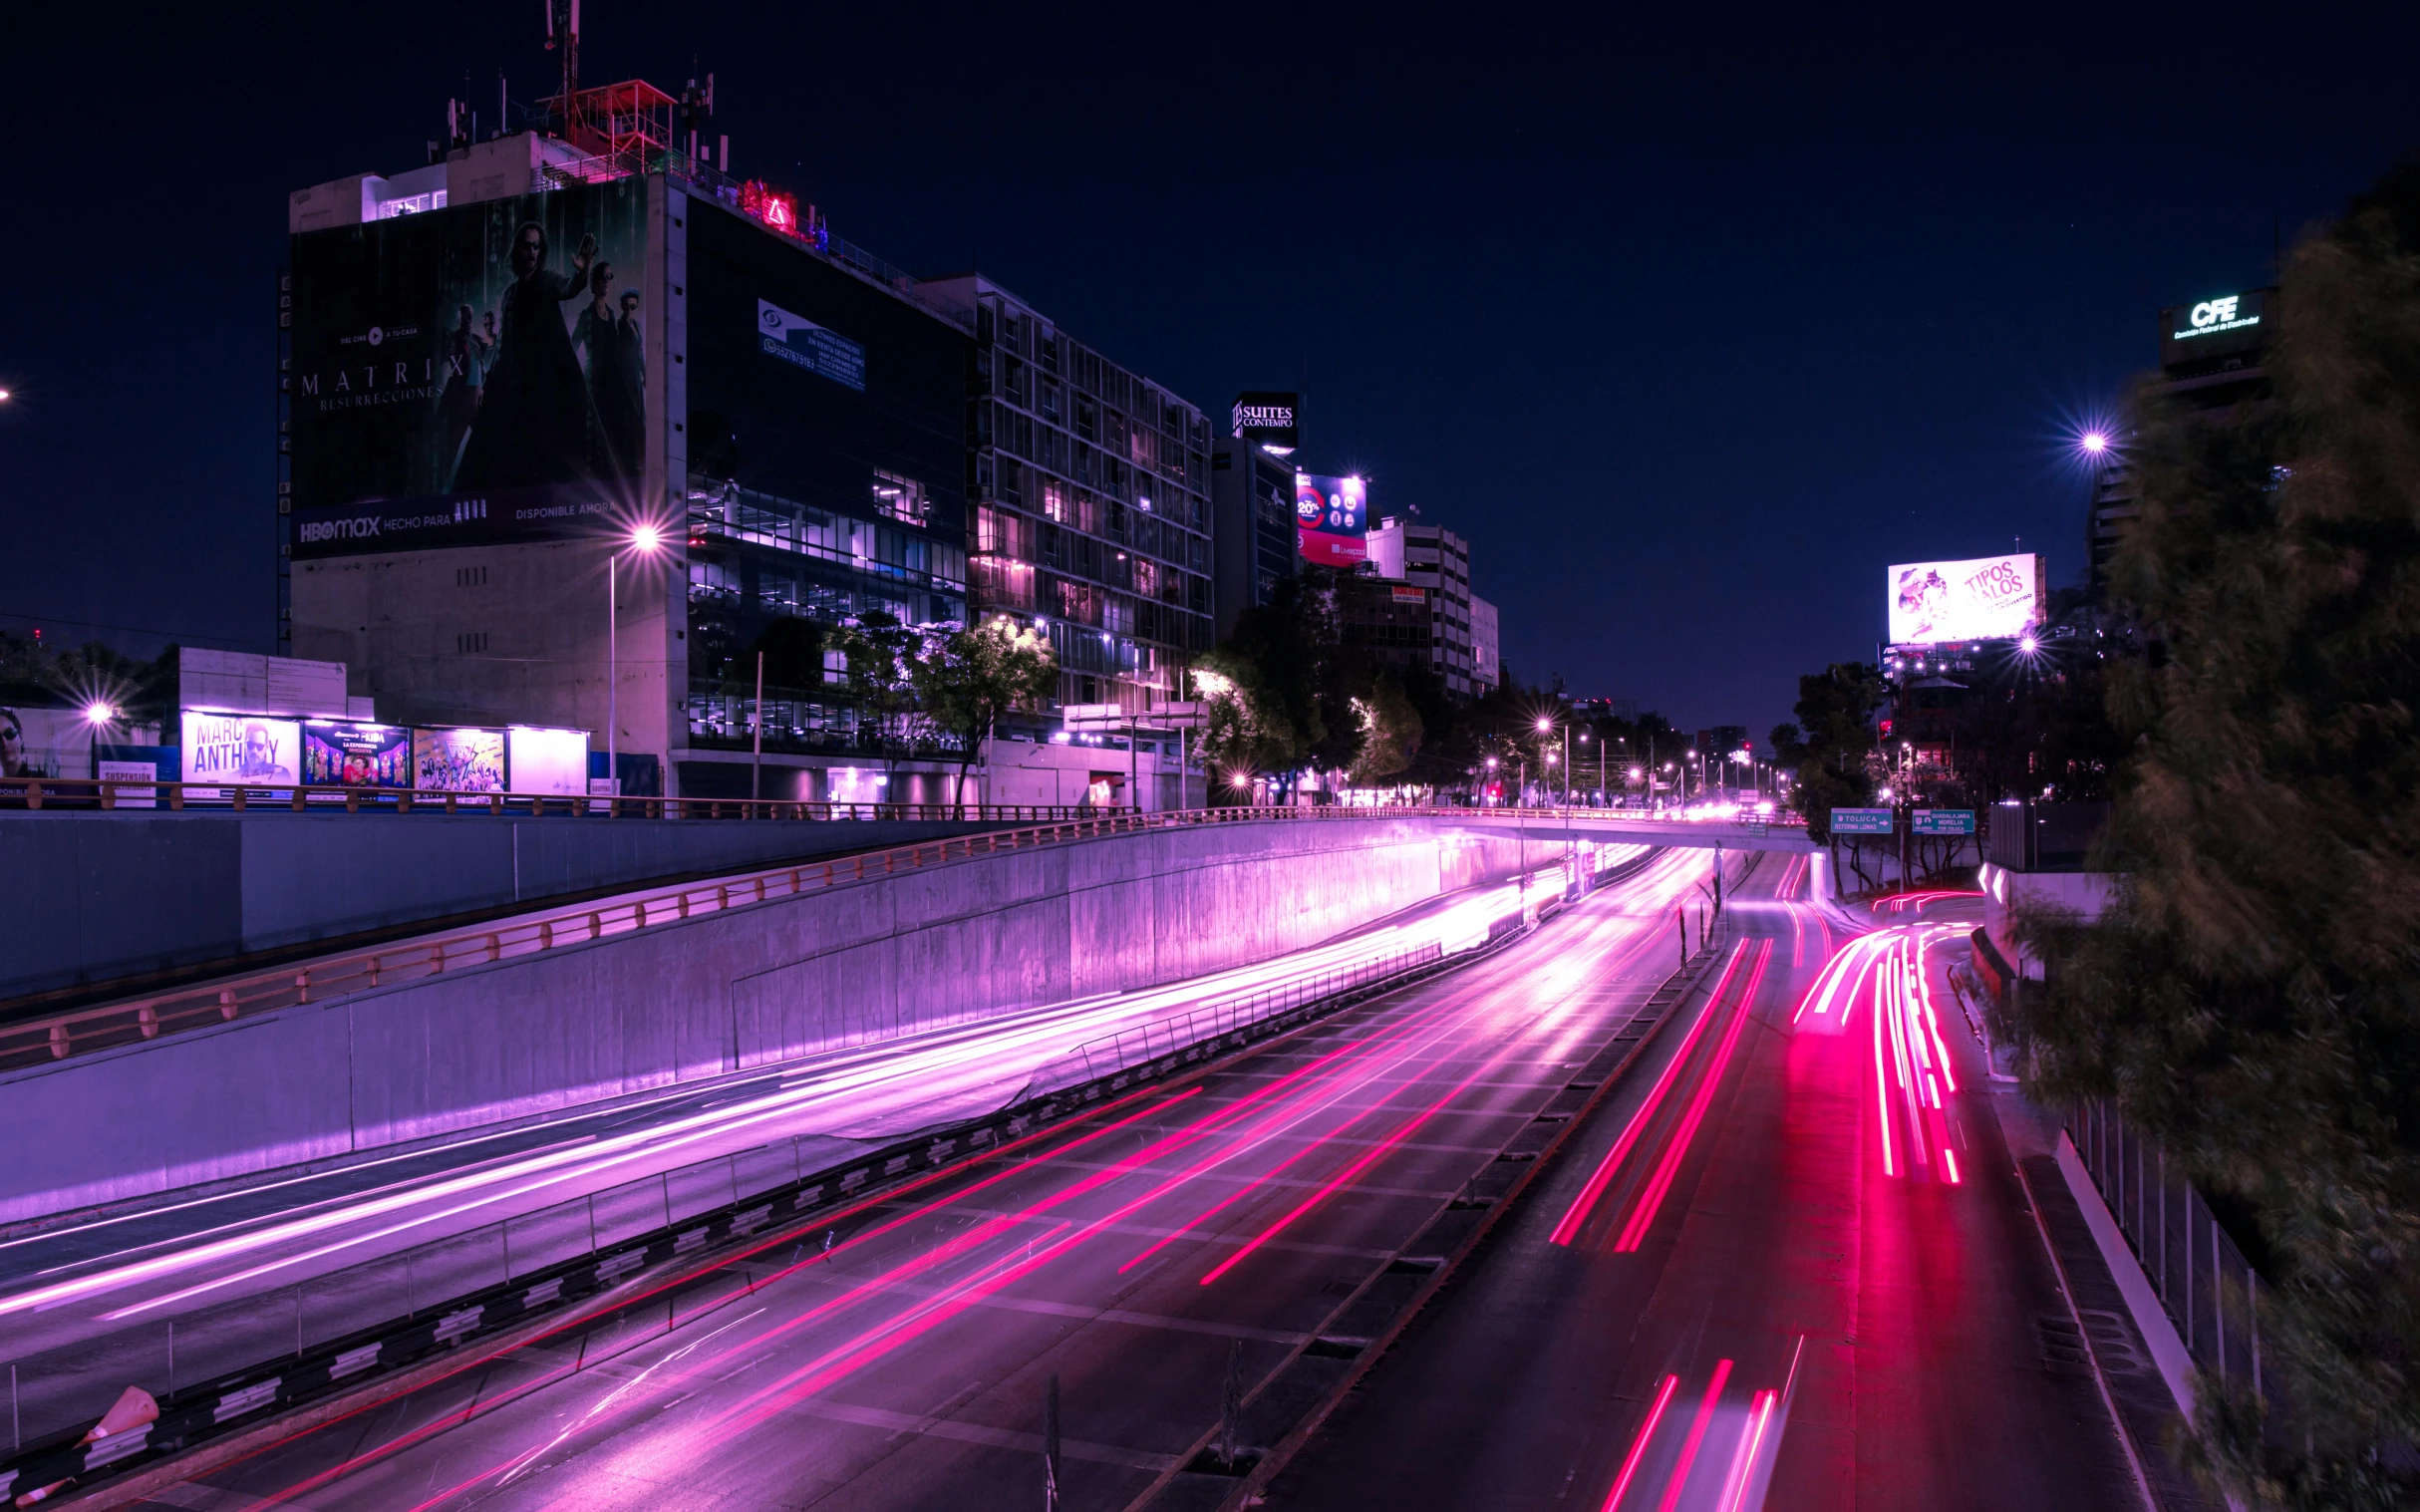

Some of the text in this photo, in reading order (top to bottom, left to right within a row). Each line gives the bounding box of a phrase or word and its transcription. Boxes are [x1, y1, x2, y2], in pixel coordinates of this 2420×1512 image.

[2191, 295, 2239, 327] CFE
[400, 327, 417, 336] CASA
[2199, 324, 2219, 335] Federal
[352, 334, 367, 343] CINE
[836, 337, 860, 355] ESPACIOS
[808, 337, 816, 346] EN
[817, 340, 834, 354] RENTA
[834, 348, 851, 361] DESDE
[818, 350, 857, 372] INFORMES
[302, 354, 464, 397] MATRIX
[320, 386, 443, 411] RESURRECCIONES
[1243, 406, 1293, 419] SUITES
[1243, 418, 1293, 427] CONTEMPO
[516, 502, 616, 520] DISPONIBLE AHORA
[1298, 502, 1320, 514] 20%
[384, 517, 421, 531] HECHO
[424, 515, 451, 527] PARA
[1340, 546, 1366, 556] Liverpool
[1964, 561, 2013, 592] TIPOS
[197, 719, 242, 745] MARC
[361, 732, 385, 743] FRIDA
[194, 739, 279, 773] ANTHY
[105, 772, 151, 781] SUSPENSIÓN
